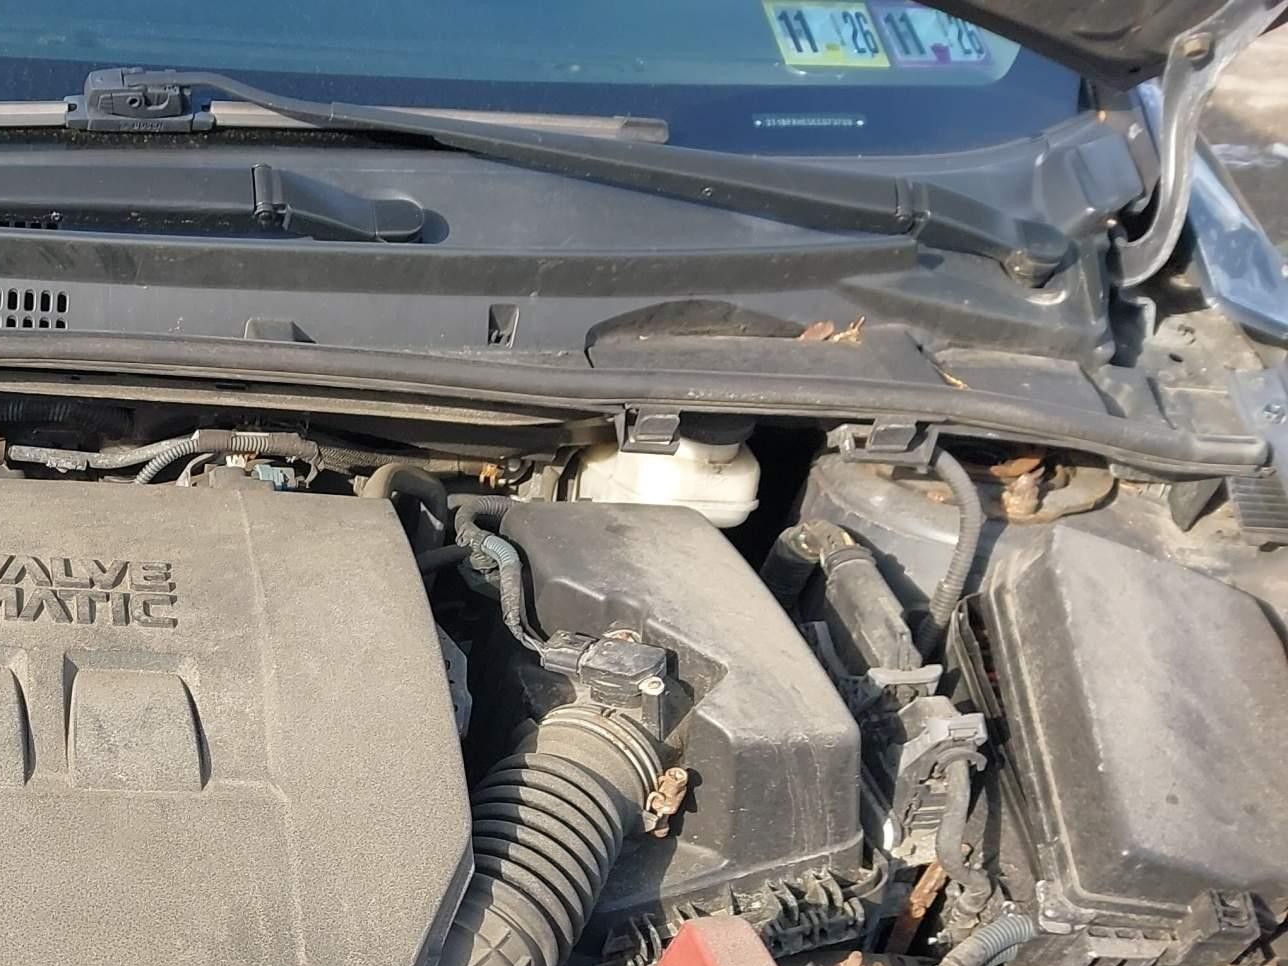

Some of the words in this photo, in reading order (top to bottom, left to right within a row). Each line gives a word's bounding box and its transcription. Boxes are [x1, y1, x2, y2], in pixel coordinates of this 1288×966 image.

[778, 10, 819, 53] 11
[842, 11, 879, 54] 26
[884, 12, 926, 55] 11
